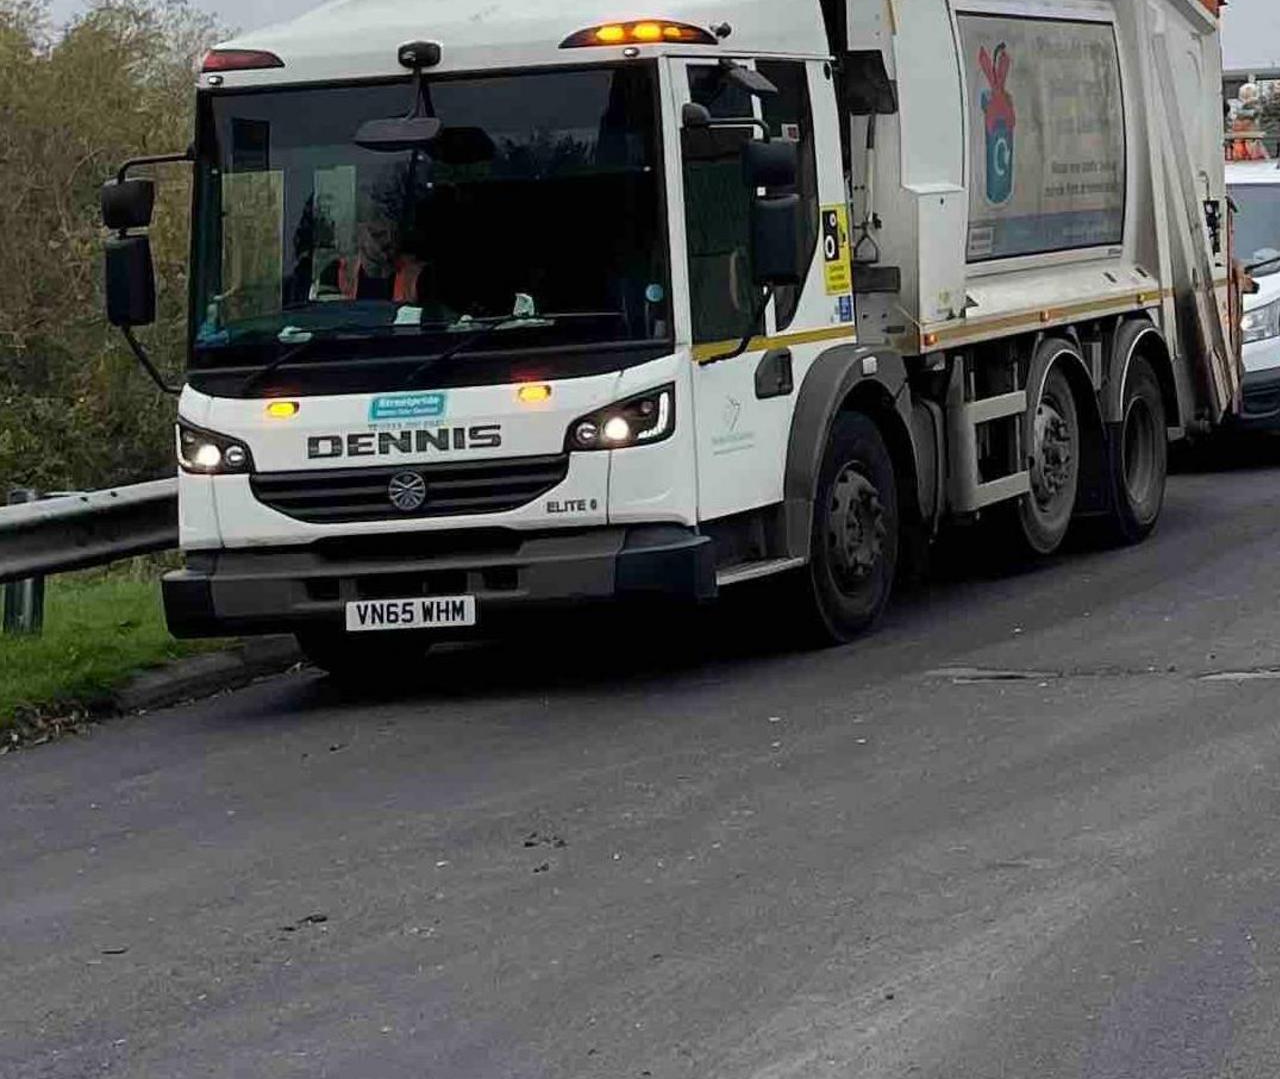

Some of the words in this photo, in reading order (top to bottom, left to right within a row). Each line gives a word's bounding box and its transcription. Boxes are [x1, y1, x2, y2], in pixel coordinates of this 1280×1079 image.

[307, 424, 502, 459] DENNIS
[546, 499, 587, 514] ELITE
[356, 601, 415, 626] VN65
[421, 599, 465, 623] WHM
